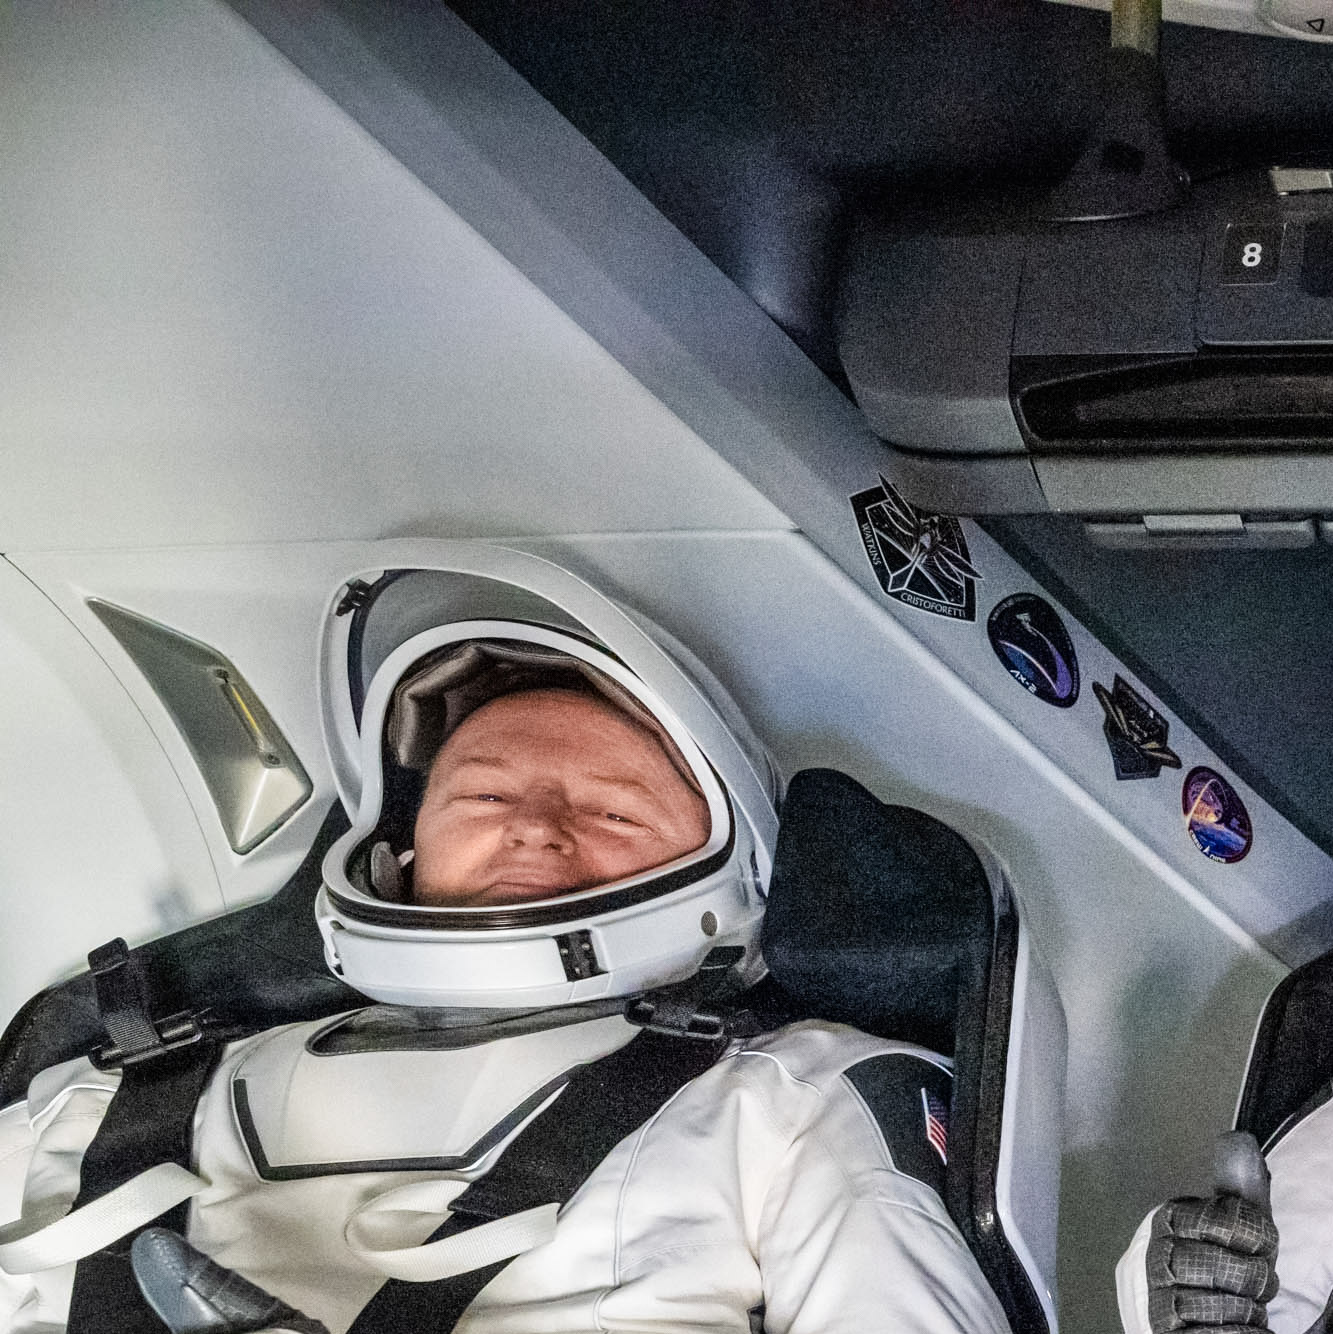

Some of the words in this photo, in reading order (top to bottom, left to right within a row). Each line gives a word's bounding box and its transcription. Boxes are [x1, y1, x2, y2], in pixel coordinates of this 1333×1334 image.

[1242, 242, 1262, 267] 8
[861, 522, 882, 565] WATKINS
[900, 592, 966, 617] CRISTOFORETTI
